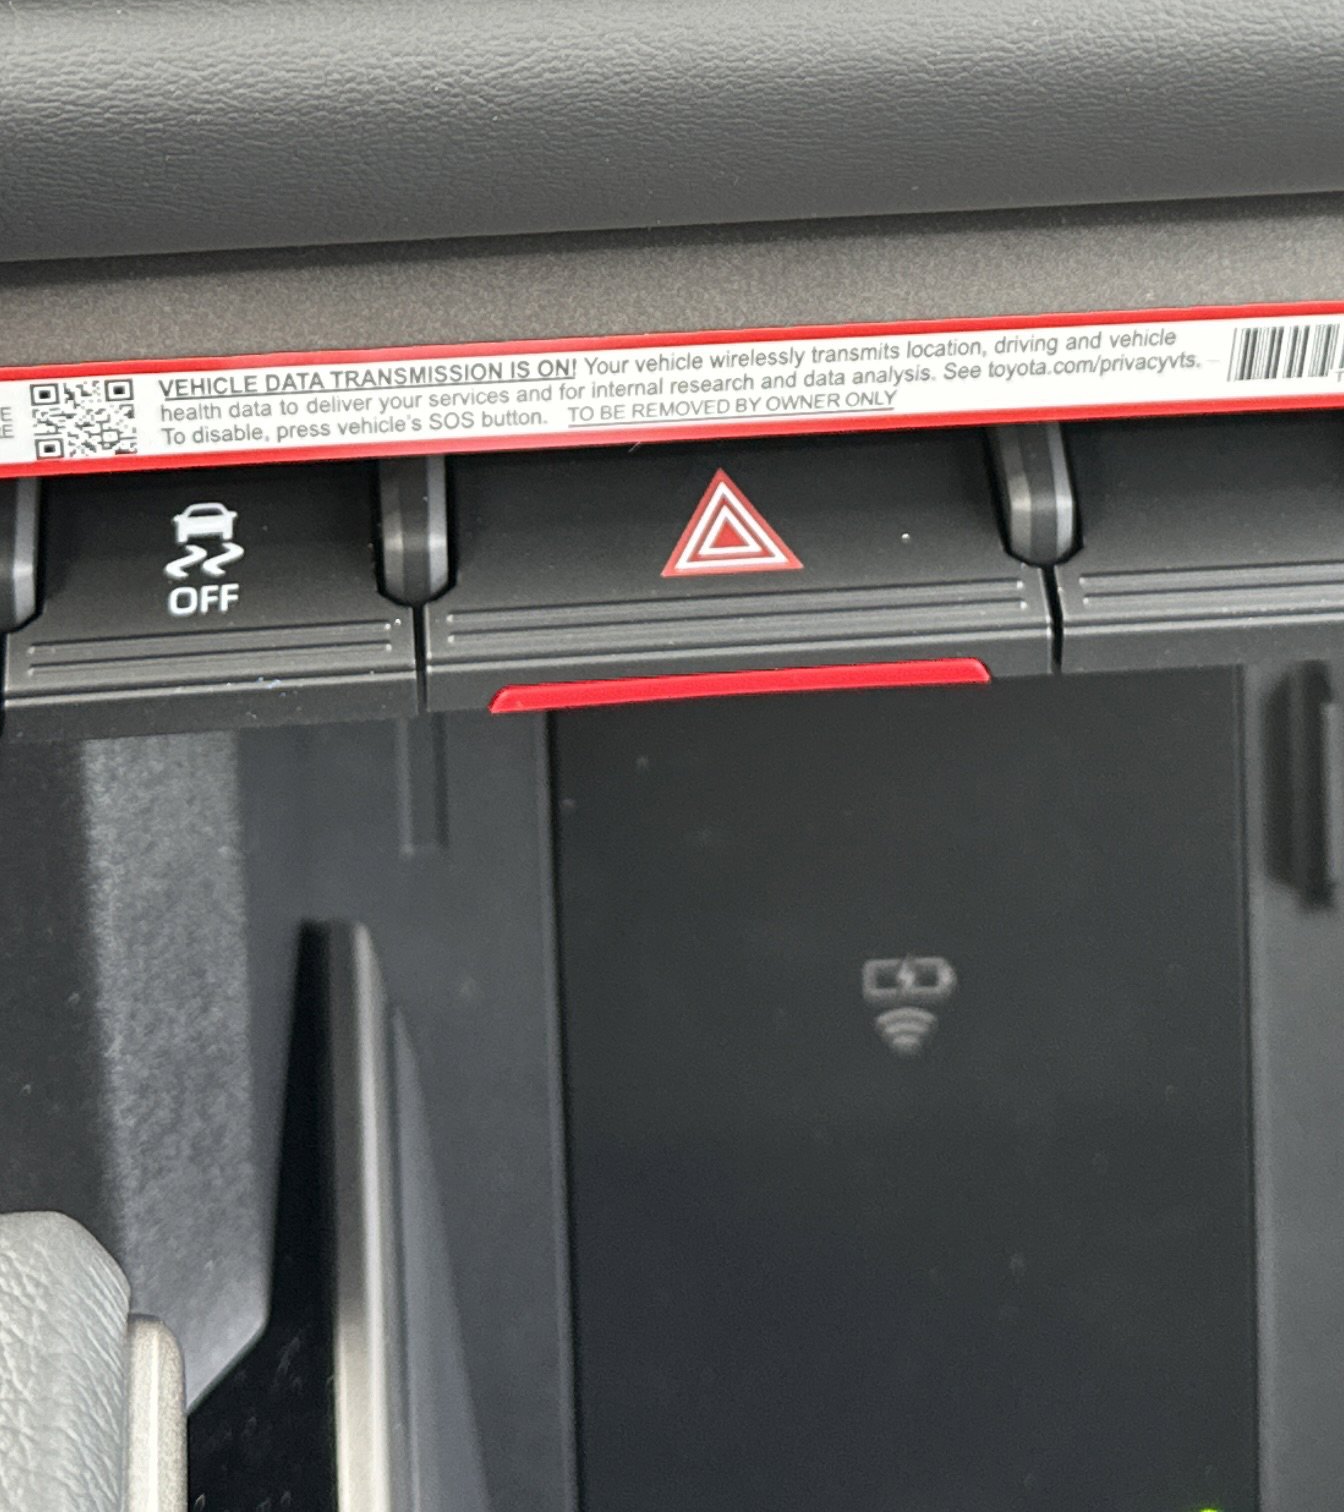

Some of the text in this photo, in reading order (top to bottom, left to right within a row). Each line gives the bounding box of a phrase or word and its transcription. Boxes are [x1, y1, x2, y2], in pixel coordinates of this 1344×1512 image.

[158, 328, 1178, 398] VEHICLE DATA TRANSMISSION IS ON! Your vehicle wirelessly transmits location, driving and vehicle
[160, 402, 223, 422] health
[228, 400, 273, 419] data
[279, 399, 300, 416] to
[306, 396, 373, 415] deliver
[378, 395, 423, 415] your
[428, 388, 511, 408] services
[516, 384, 554, 403] and
[558, 383, 586, 401] for
[591, 377, 664, 399] internal
[669, 373, 755, 395] research
[760, 371, 798, 390] and
[803, 369, 846, 388] data
[851, 364, 937, 387] analysis.
[943, 361, 983, 381] See
[161, 427, 187, 446] To
[276, 422, 332, 443] press
[337, 414, 423, 436] vehicle's
[428, 410, 476, 431] SOS
[481, 408, 549, 428] button.
[567, 406, 595, 423] TO
[599, 404, 627, 421] BE
[631, 398, 731, 420] REMOVED
[734, 396, 763, 414] BY
[765, 392, 841, 411] OWNER
[844, 389, 898, 408] ONLY
[166, 582, 240, 617] OFF
